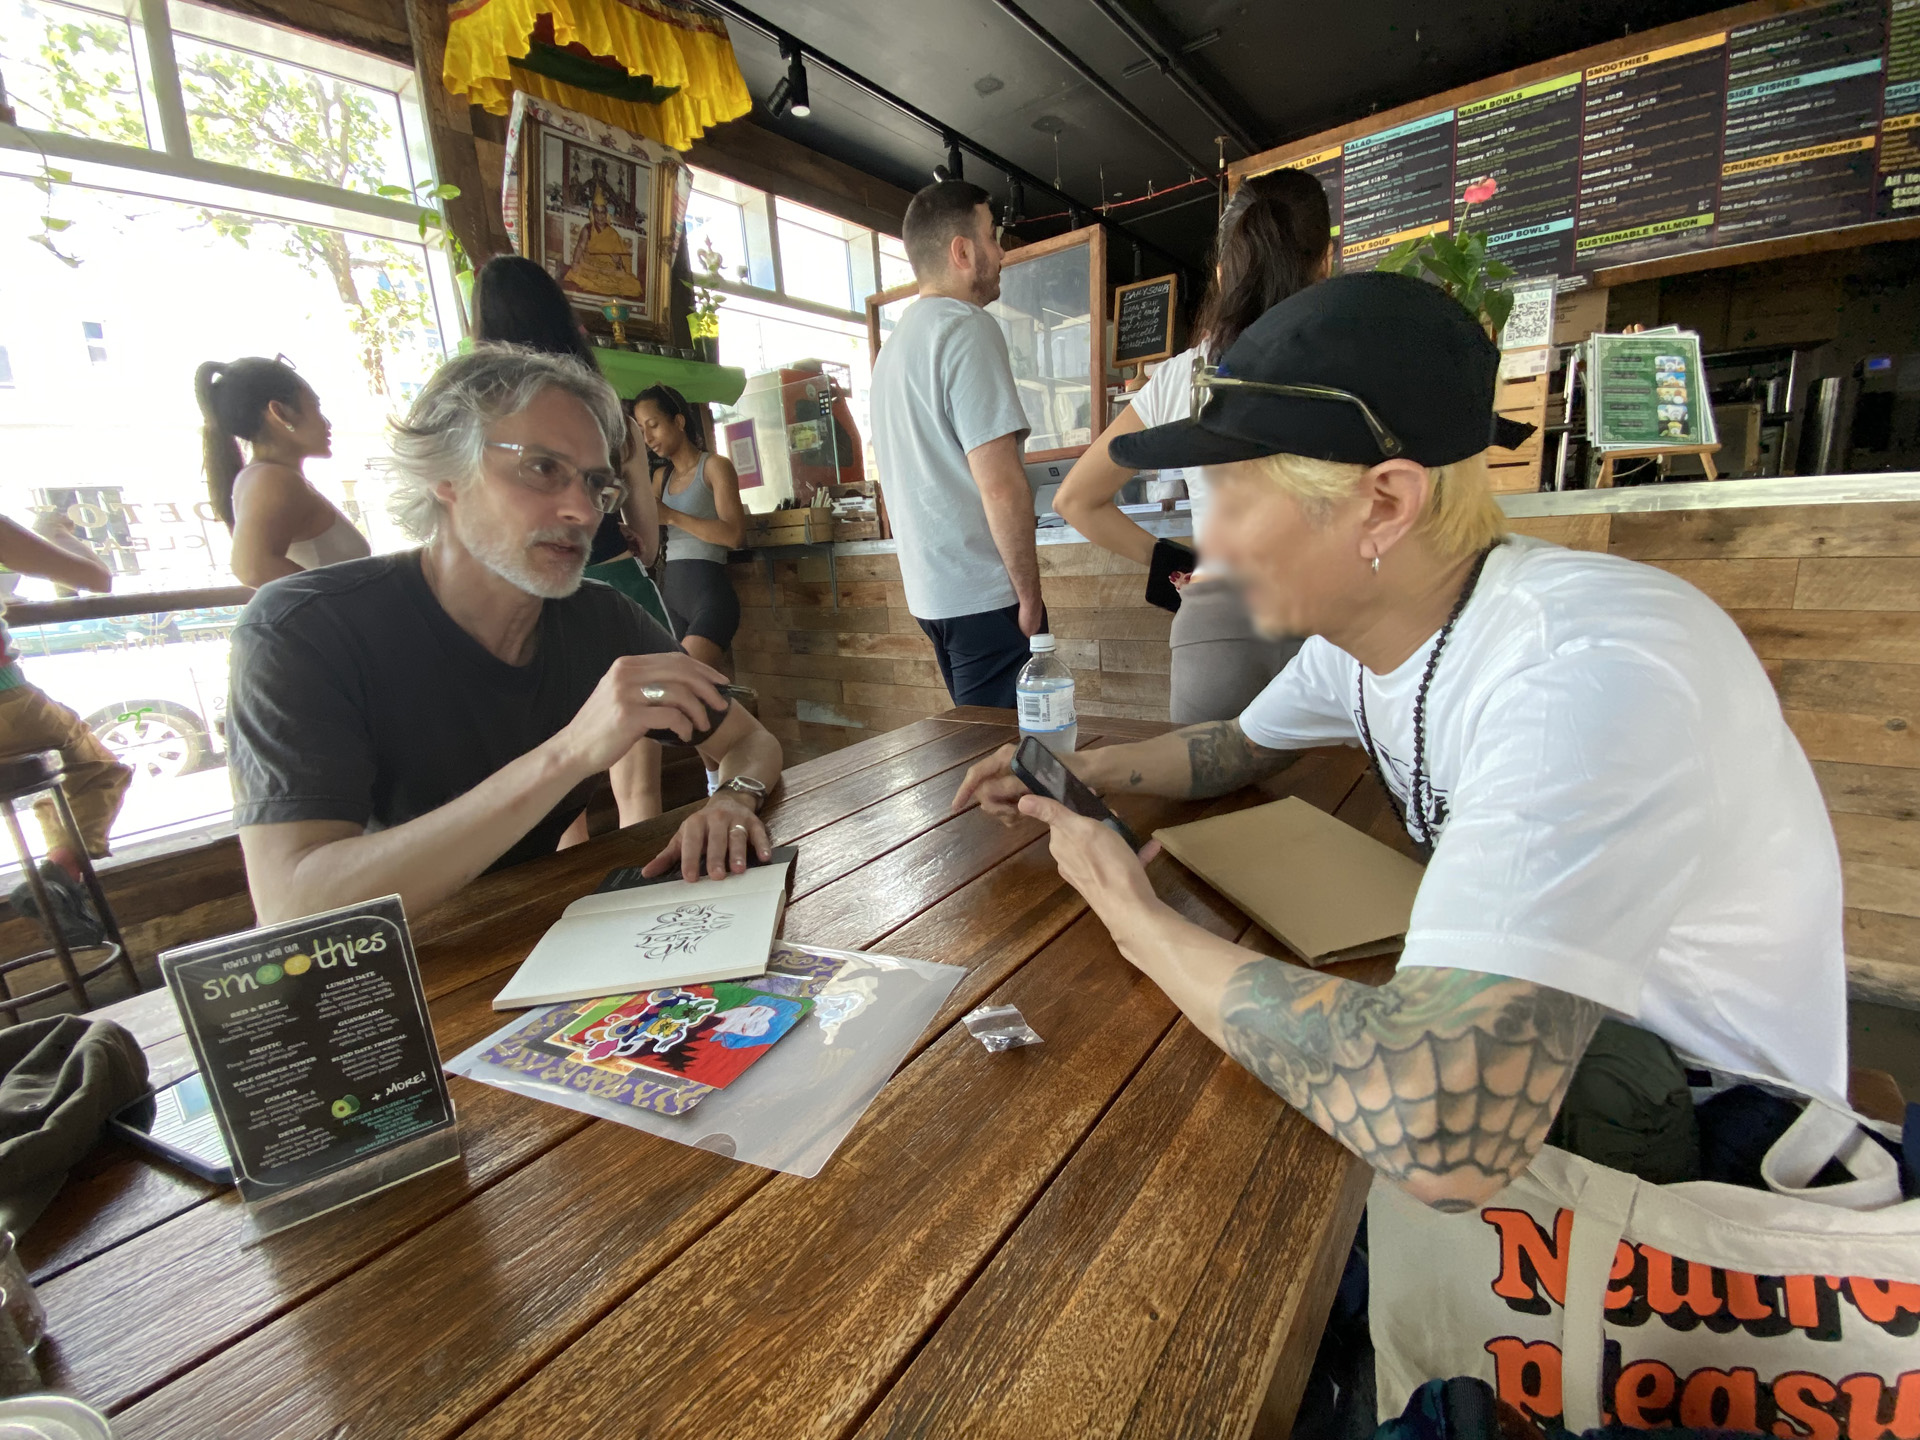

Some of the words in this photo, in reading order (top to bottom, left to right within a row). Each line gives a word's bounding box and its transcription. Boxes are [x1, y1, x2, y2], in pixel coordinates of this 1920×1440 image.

[1587, 54, 1650, 77] SMOOTHIES
[1727, 88, 1753, 100] SIDE
[1757, 78, 1800, 93] DISHES
[1458, 104, 1486, 117] WARM
[1489, 92, 1522, 108] BOWLS
[1344, 138, 1371, 152] SALAD
[1723, 155, 1779, 173] CRUNCHY
[1783, 139, 1863, 163] SANDWICHES
[1306, 155, 1321, 164] DAY
[1488, 230, 1514, 245] SOUP
[1516, 223, 1550, 240] BOWLS
[1577, 228, 1649, 249] SUSTAINABLE
[1652, 216, 1698, 233] SALMON
[1343, 241, 1366, 256] DAILY
[1368, 235, 1390, 248] SOUP
[222, 957, 249, 970] POWER
[251, 953, 262, 962] UP
[265, 947, 282, 958] WITH
[283, 943, 299, 953] OUR
[325, 977, 354, 989] LUNCH
[355, 971, 376, 981] DATE
[230, 1009, 249, 1018] RED
[257, 999, 280, 1010] BLUE
[338, 1008, 384, 1026] GUAVACADO
[249, 1041, 282, 1055] EXOTIC
[331, 1051, 353, 1062] BLIND
[354, 1045, 373, 1054] DATE
[373, 1034, 407, 1048] TROPICAL
[232, 1077, 254, 1087] KALE
[254, 1066, 288, 1080] ORANGE
[289, 1056, 317, 1069] POWER
[386, 1071, 426, 1095] MORE!
[264, 1089, 297, 1103] COLADA
[278, 1125, 306, 1138] DETOX
